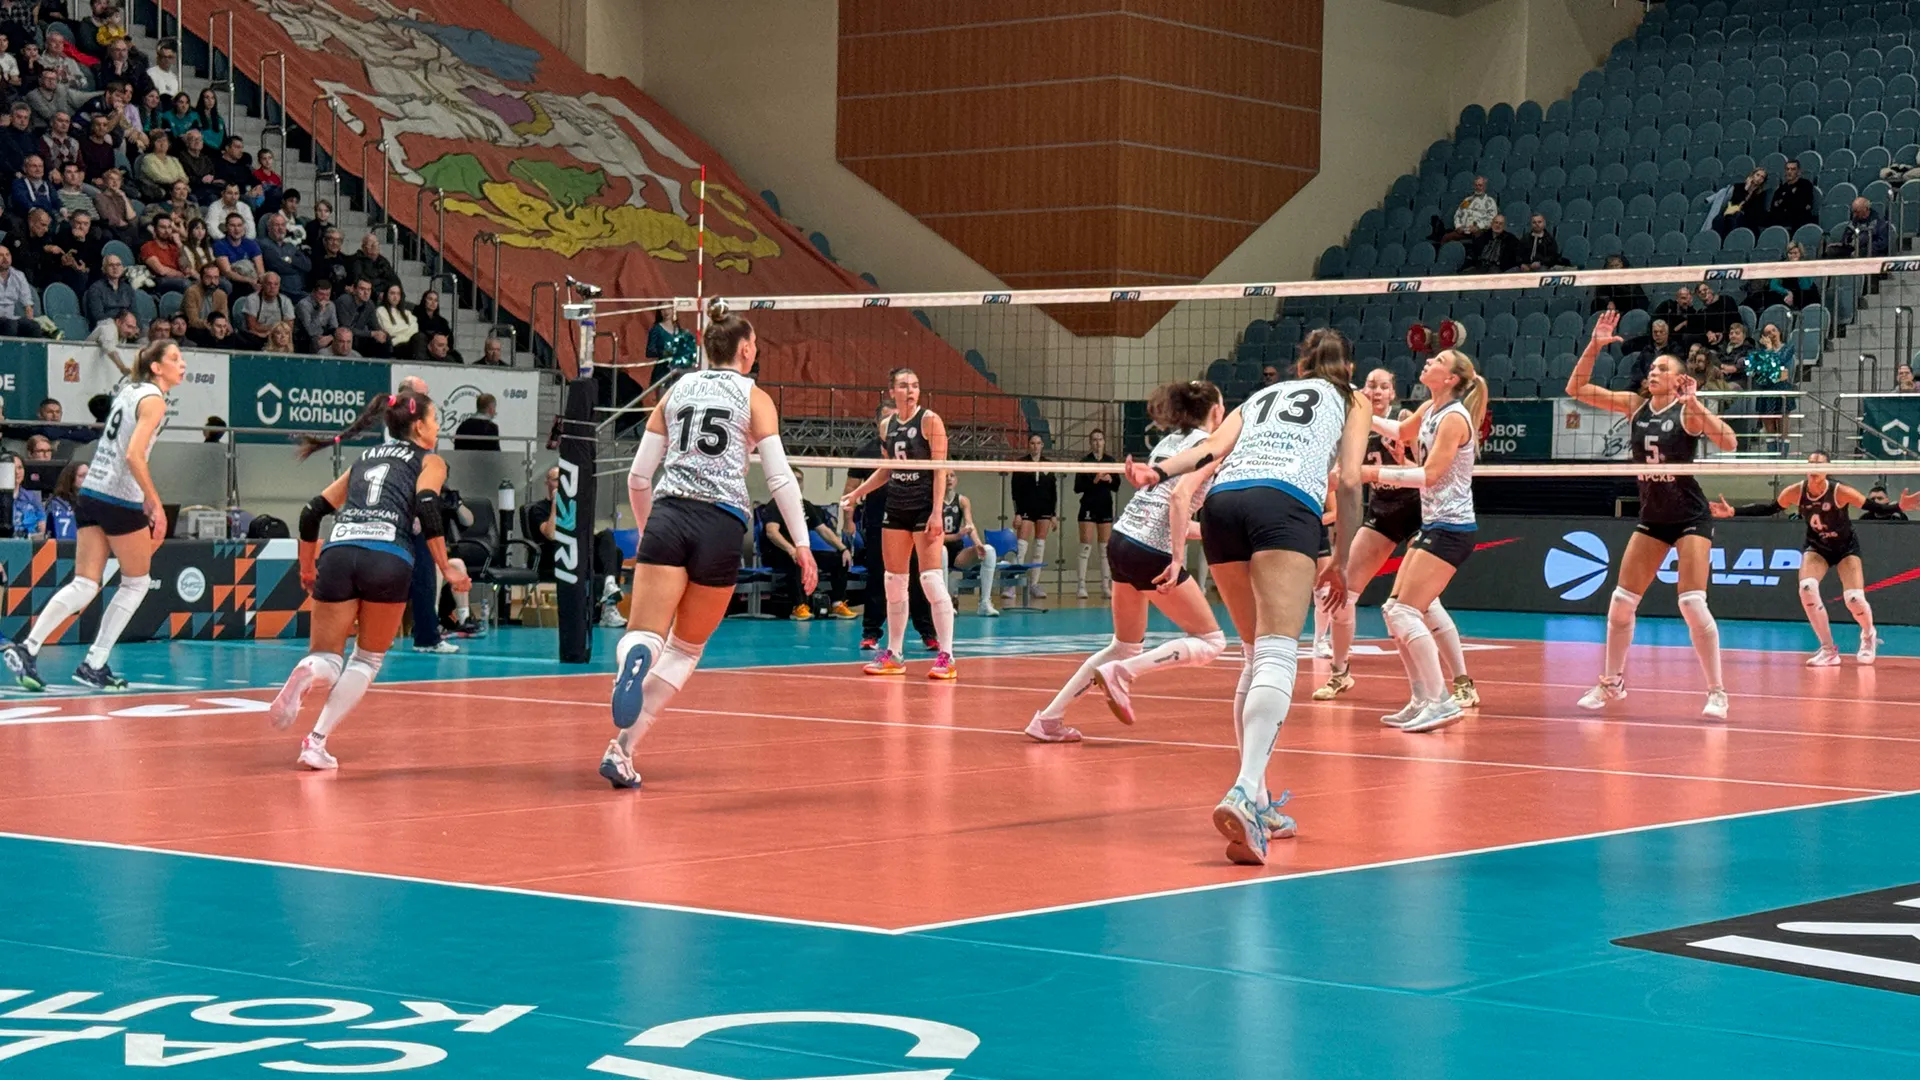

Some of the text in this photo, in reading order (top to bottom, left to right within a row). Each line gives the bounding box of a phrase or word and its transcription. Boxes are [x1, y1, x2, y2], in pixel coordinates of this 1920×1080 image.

[288, 387, 366, 406] САДОВОЕ
[1254, 387, 1322, 427] 13
[107, 408, 123, 440] 9
[289, 407, 356, 426] КОЛЬЦО
[676, 403, 733, 458] 15
[1644, 435, 1660, 464] 5
[363, 463, 390, 506] 1
[58, 518, 71, 537] 7
